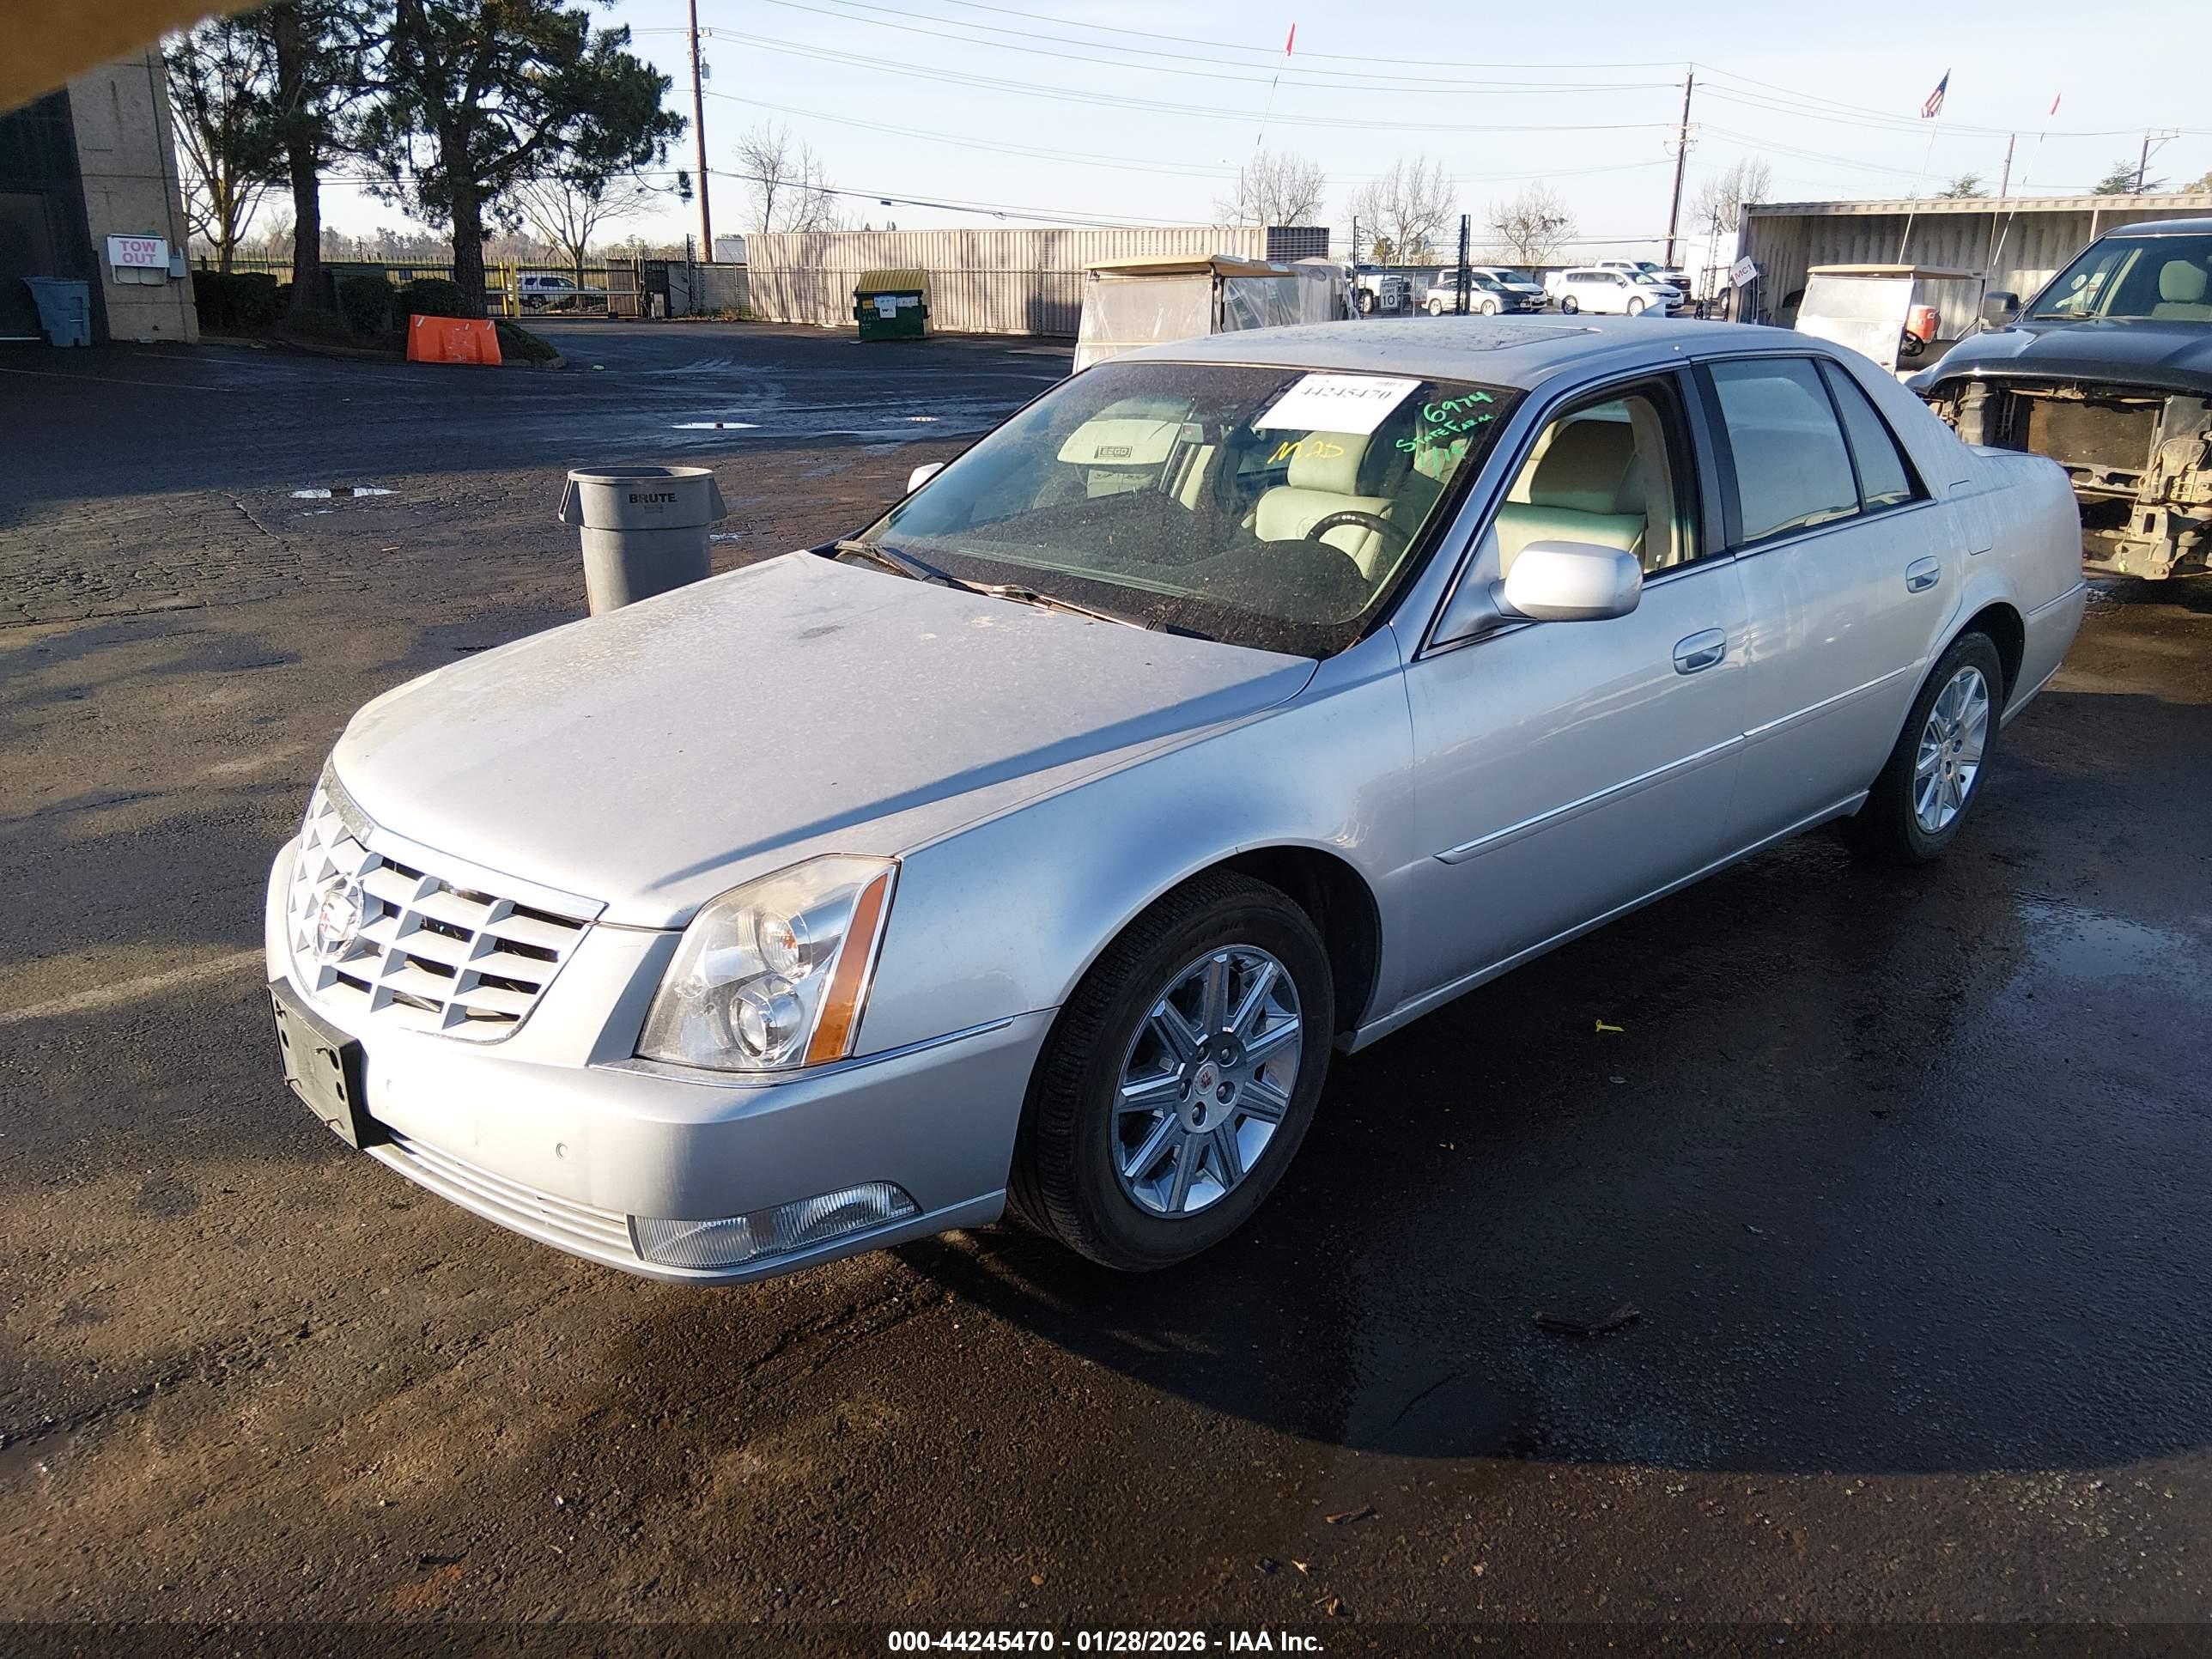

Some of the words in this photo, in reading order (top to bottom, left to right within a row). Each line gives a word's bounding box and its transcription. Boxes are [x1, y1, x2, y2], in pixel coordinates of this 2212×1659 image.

[118, 240, 156, 252] TOW
[122, 252, 156, 264] OUT
[1735, 264, 1753, 280] MC1
[1382, 295, 1395, 306] 10
[1423, 392, 1494, 422] 6974
[629, 493, 678, 504] BRUTE
